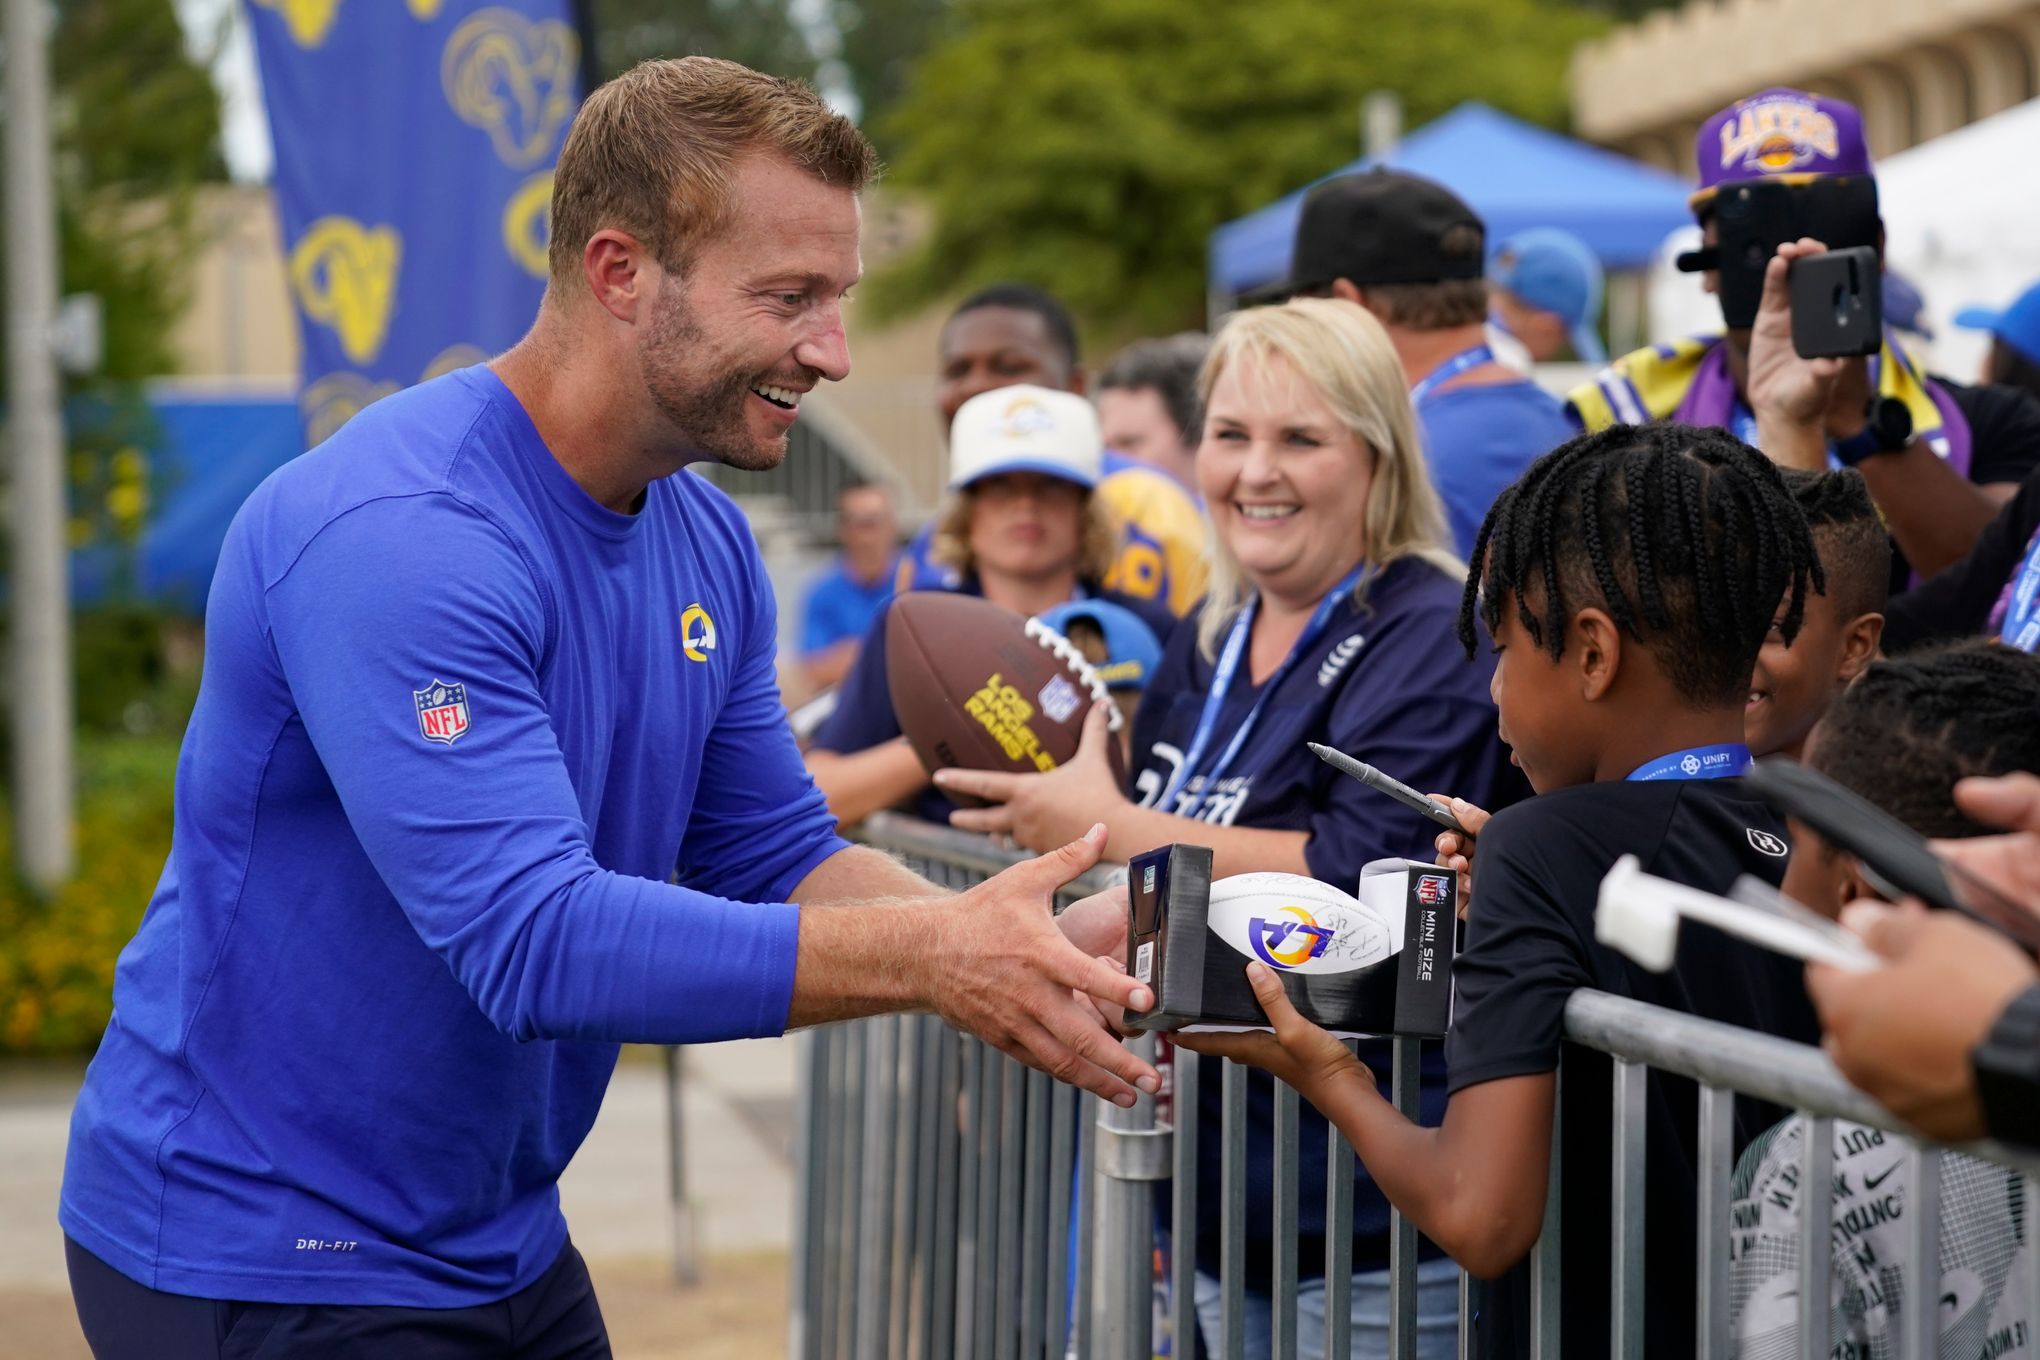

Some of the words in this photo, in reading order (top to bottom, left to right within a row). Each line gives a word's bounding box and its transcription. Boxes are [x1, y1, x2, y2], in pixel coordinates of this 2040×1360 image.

[1719, 102, 1840, 170] LAKERS
[986, 673, 1035, 721] LOS
[423, 705, 466, 735] NFL
[964, 696, 1026, 760] RAMS
[975, 687, 1057, 773] ANGELE
[1702, 753, 1730, 765] UNIFY
[1418, 879, 1438, 905] NFL
[1418, 910, 1427, 948] COLLECTIBLE
[1425, 910, 1436, 942] MINI
[1421, 947, 1434, 982] SIZE
[295, 1238, 358, 1252] DRI-FIT
